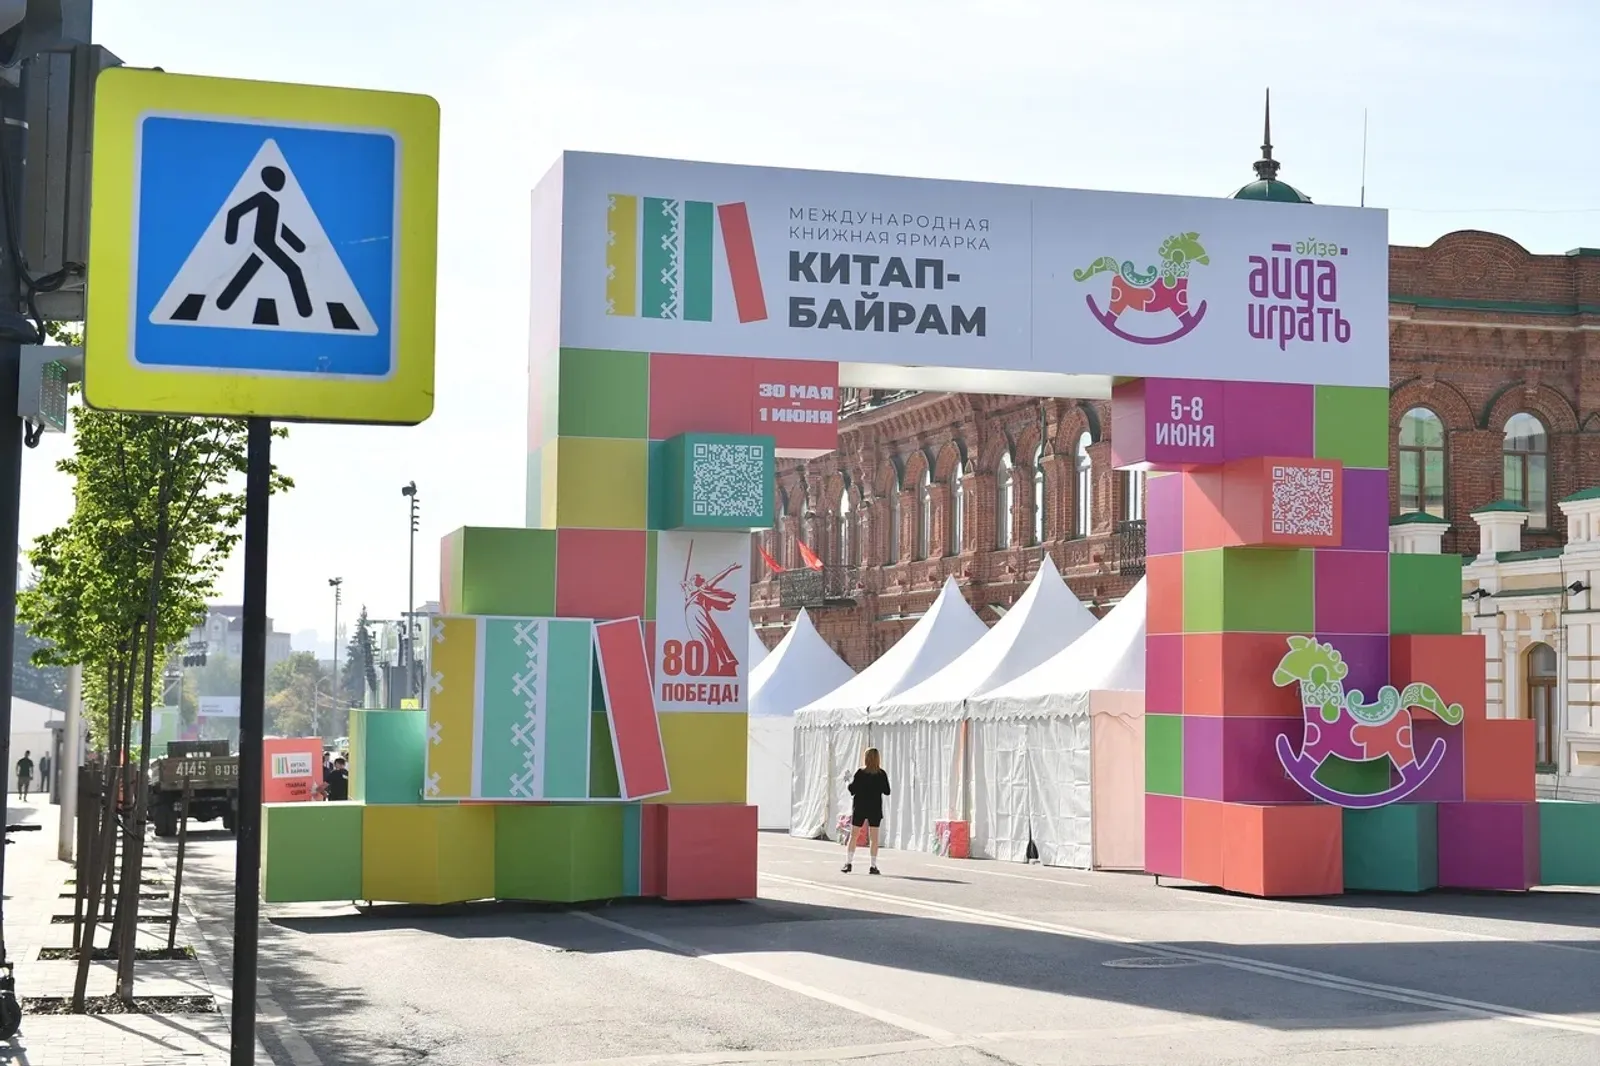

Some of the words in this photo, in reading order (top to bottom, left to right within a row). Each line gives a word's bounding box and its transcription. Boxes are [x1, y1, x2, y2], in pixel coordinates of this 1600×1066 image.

[789, 206, 991, 232] МЕЖДУНАРОДНАЯ
[789, 226, 890, 245] КНИЖНАЯ
[895, 232, 991, 251] ЯРМАРКА
[788, 250, 961, 290] КИТАП-
[788, 291, 987, 337] БАЙРАМ
[1247, 303, 1352, 352] играть
[759, 383, 786, 398] 30
[789, 384, 834, 400] МАЯ
[759, 407, 768, 422] 1
[771, 408, 833, 424] ИЮНЯ
[1170, 395, 1204, 422] 5-8
[1155, 422, 1215, 448] ИЮНЯ
[662, 639, 705, 677] 80
[661, 683, 740, 706] ПОБЕДА!
